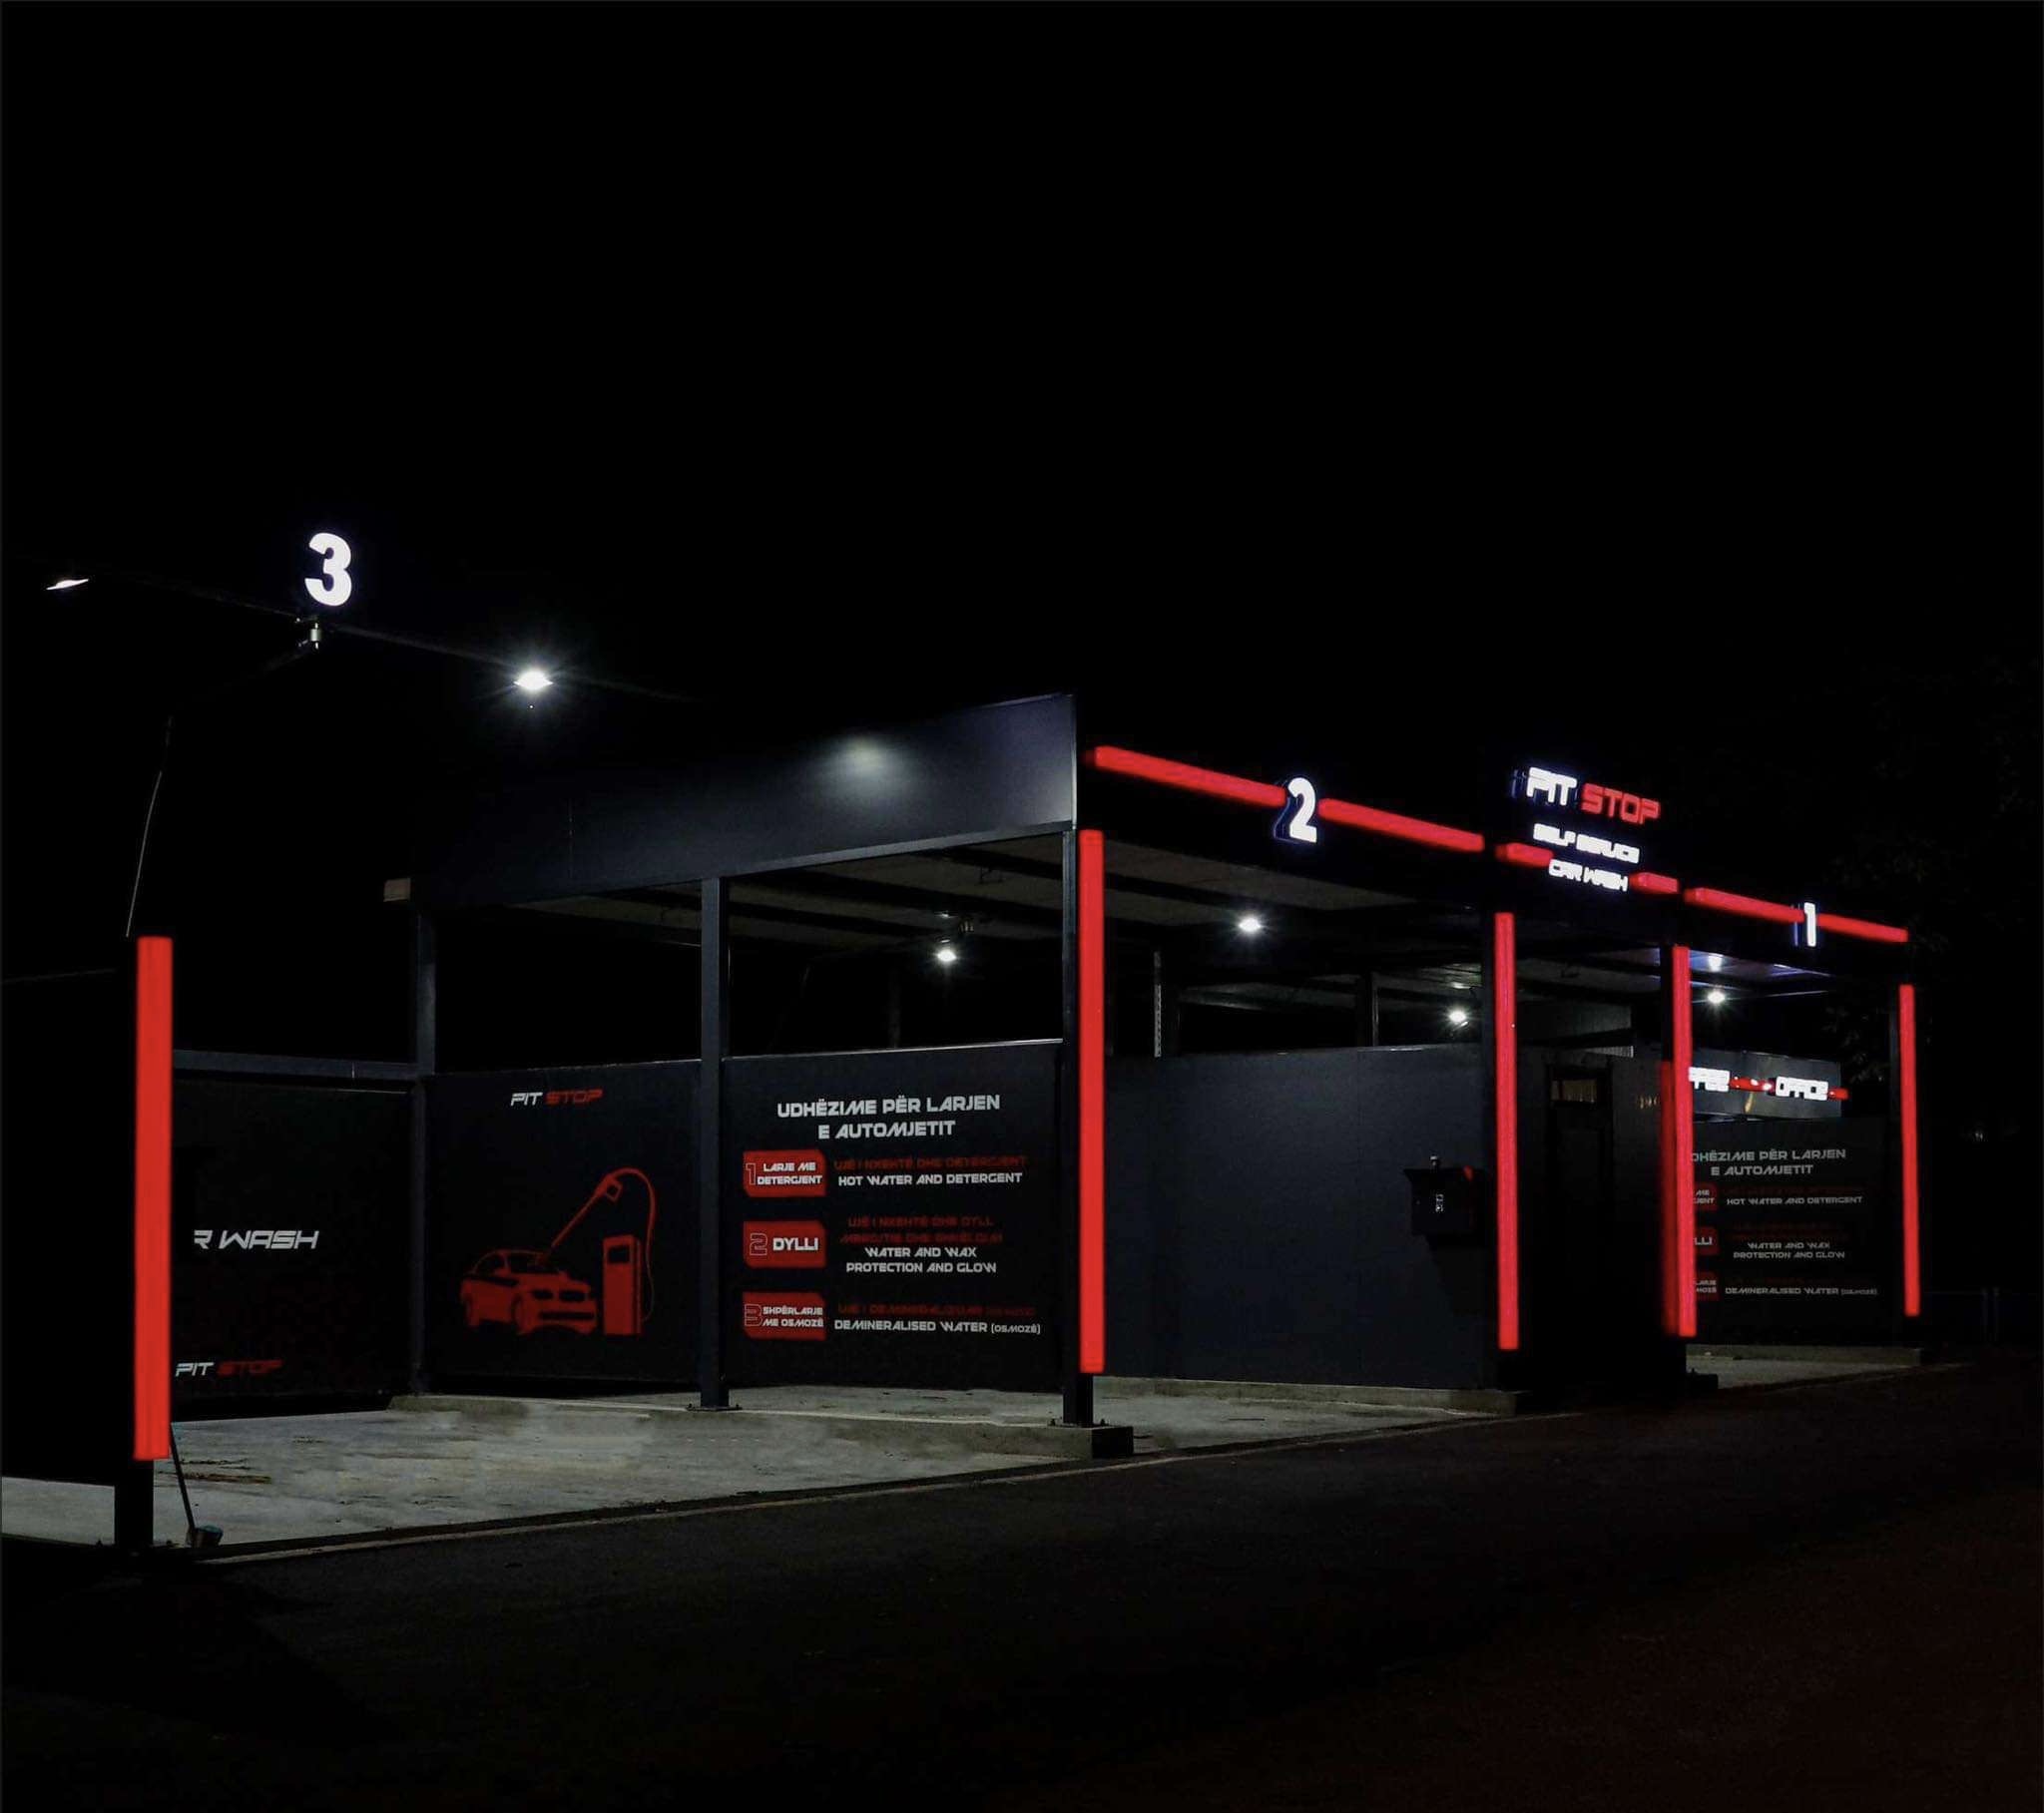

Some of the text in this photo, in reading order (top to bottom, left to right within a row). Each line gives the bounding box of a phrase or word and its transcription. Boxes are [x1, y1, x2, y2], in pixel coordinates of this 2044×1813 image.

[304, 533, 351, 606] 3
[1526, 767, 1661, 824] PIT STOP
[1288, 777, 1316, 843] 2
[1549, 859, 1628, 891] CAR WASH
[1804, 902, 1816, 947] 1
[511, 1089, 603, 1106] PIT STOP
[1776, 1076, 1828, 1101] OFFICE
[777, 1095, 1000, 1118] UDHËZIME PËR LARJEN
[818, 1121, 955, 1139] E AUTOMJETIT
[1691, 1148, 1845, 1163] DHËZIME PËR LARJEN
[746, 1161, 758, 1187] 1
[764, 1162, 794, 1171] LARJE
[1711, 1164, 1813, 1175] E AUTOMJETIT
[758, 1175, 822, 1184] DETERGJENT
[838, 1172, 1022, 1185] HOT WATER AND DETERGENT
[219, 1230, 319, 1249] WASH
[748, 1231, 818, 1257] 2 DYLLI
[865, 1247, 976, 1257] WATER AND WAX
[846, 1262, 996, 1272] PROTECTION AND GLOW
[744, 1302, 762, 1328] 3
[834, 1320, 1040, 1334] DEMINERALISED WATER (OSMOZË)
[176, 1362, 214, 1376] PIT
